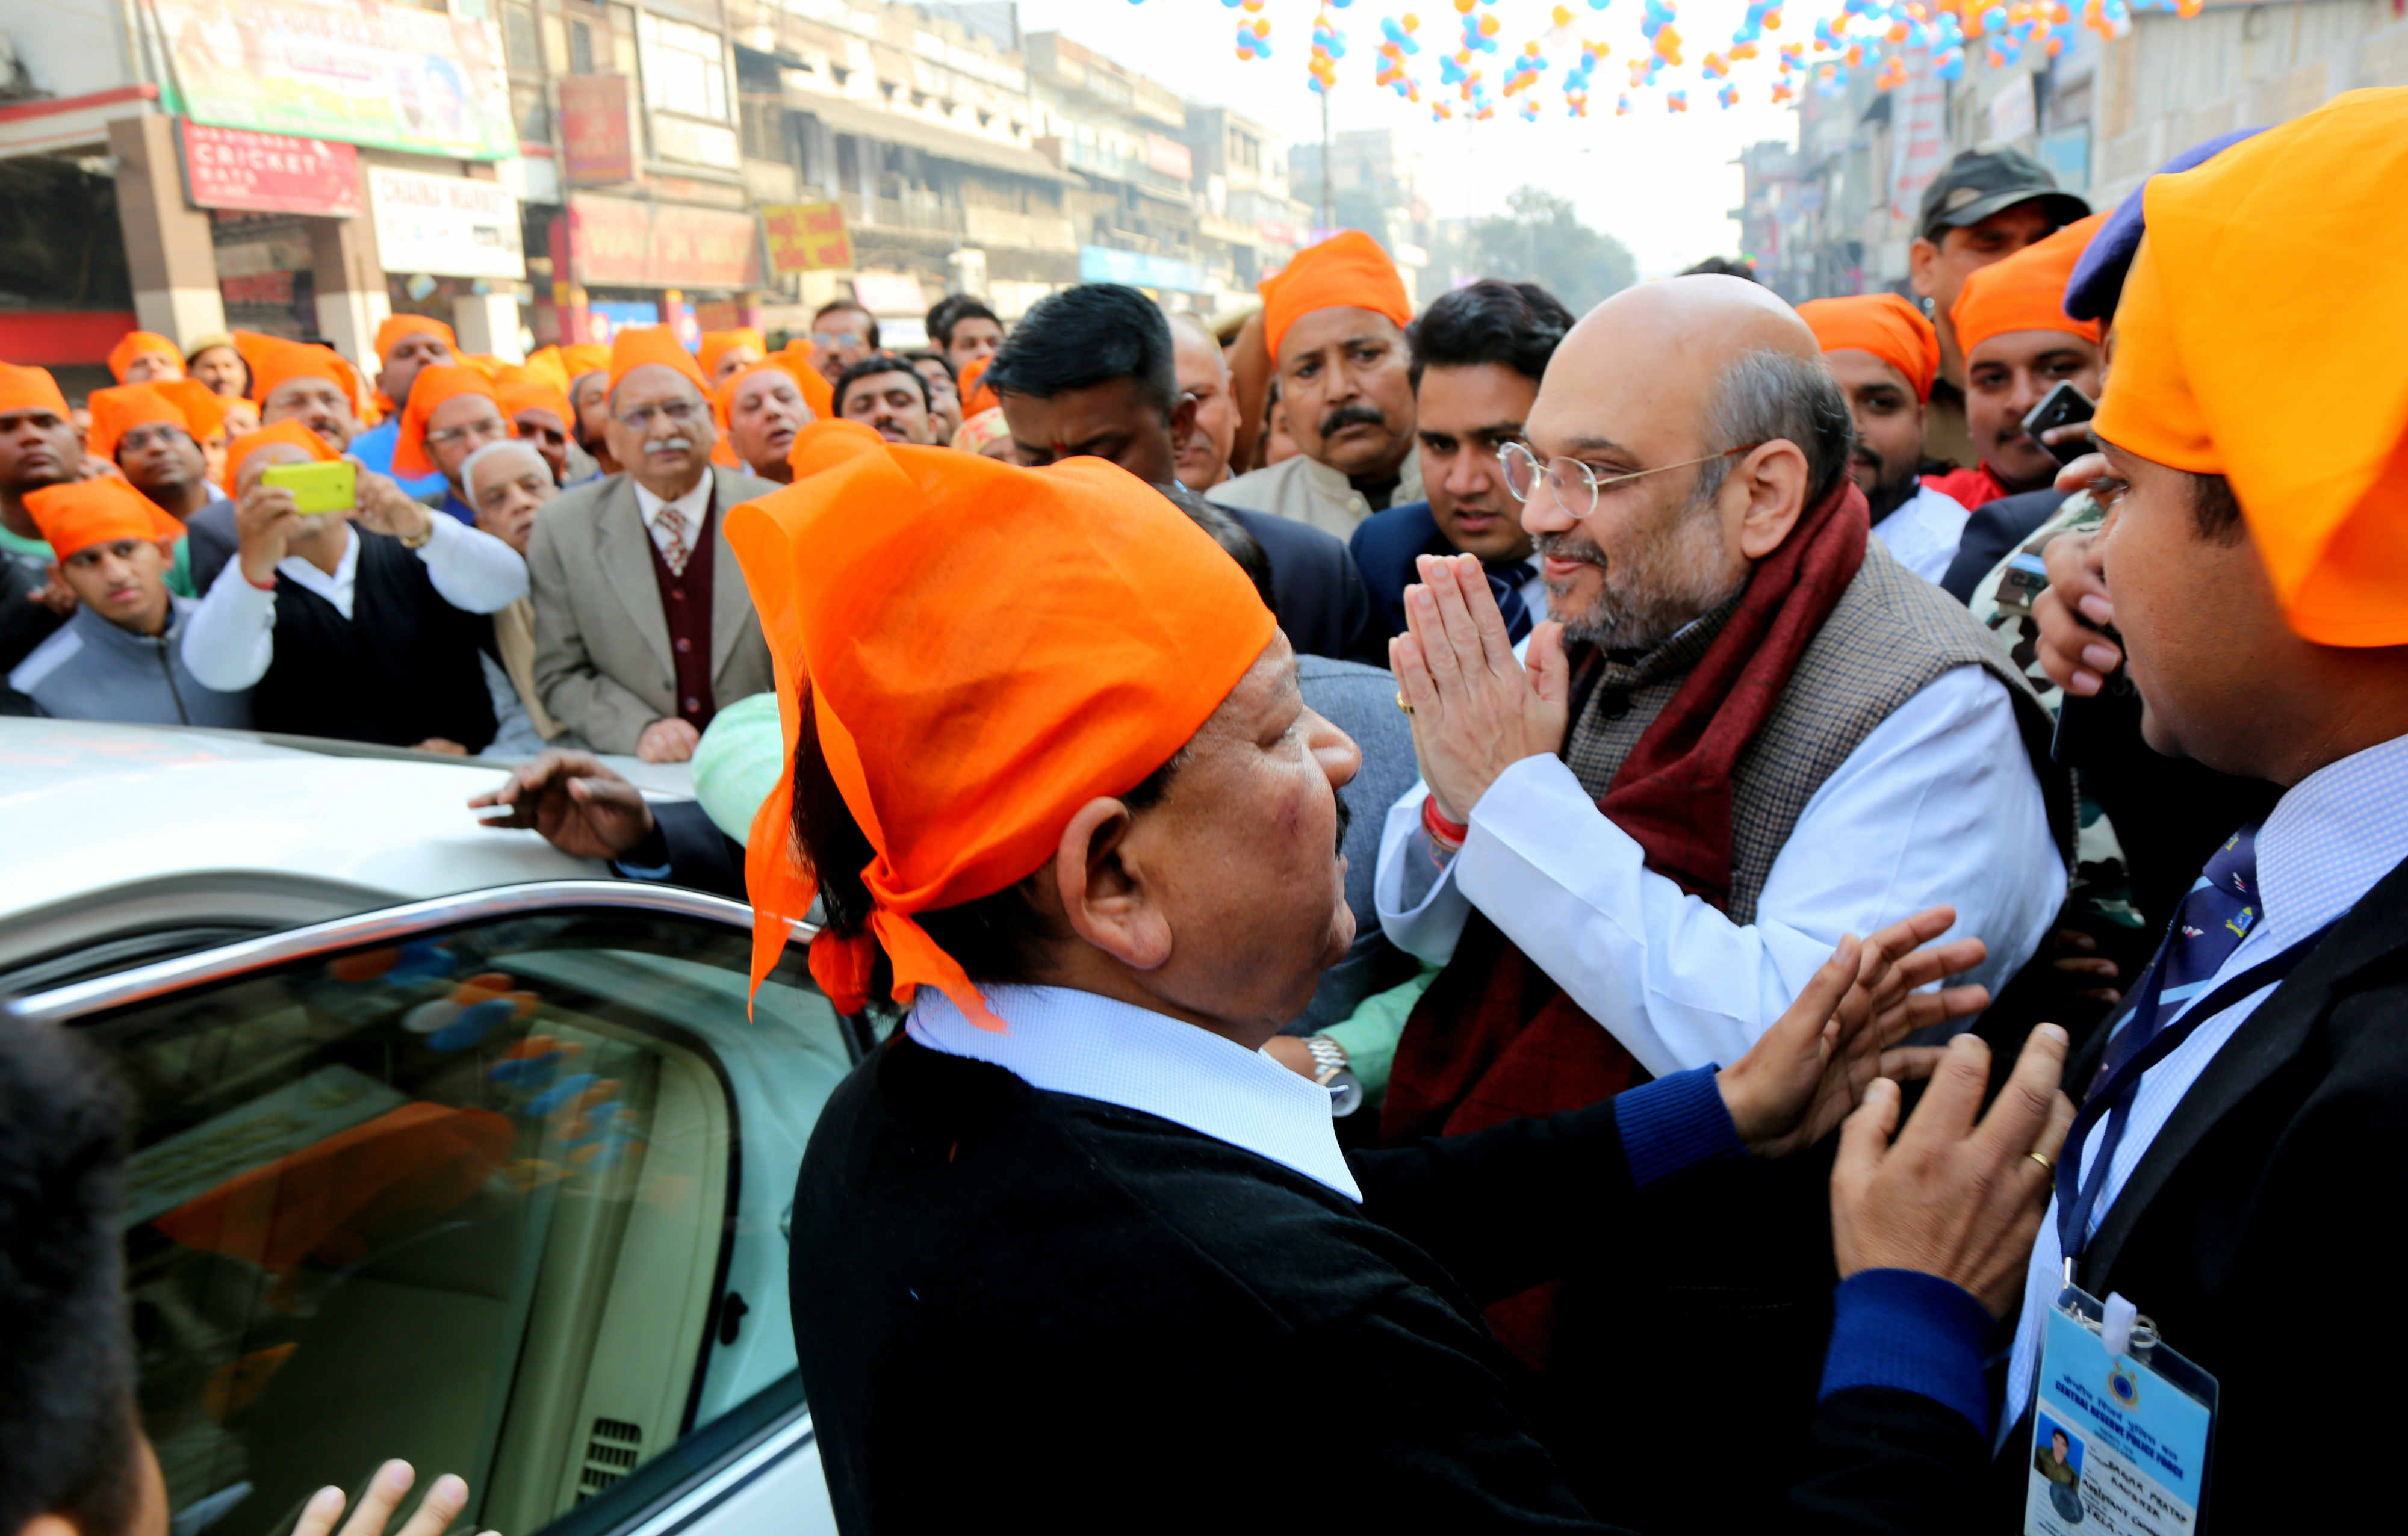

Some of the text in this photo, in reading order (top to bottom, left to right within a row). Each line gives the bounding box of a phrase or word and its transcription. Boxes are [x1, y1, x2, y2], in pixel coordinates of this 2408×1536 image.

[194, 143, 315, 175] CRICKET
[198, 165, 257, 187] BATS
[2055, 1380, 2088, 1411] CENTRAL
[2090, 1404, 2124, 1436] RESERVE
[2126, 1429, 2155, 1459] POLICE
[2156, 1452, 2184, 1481] FORCE
